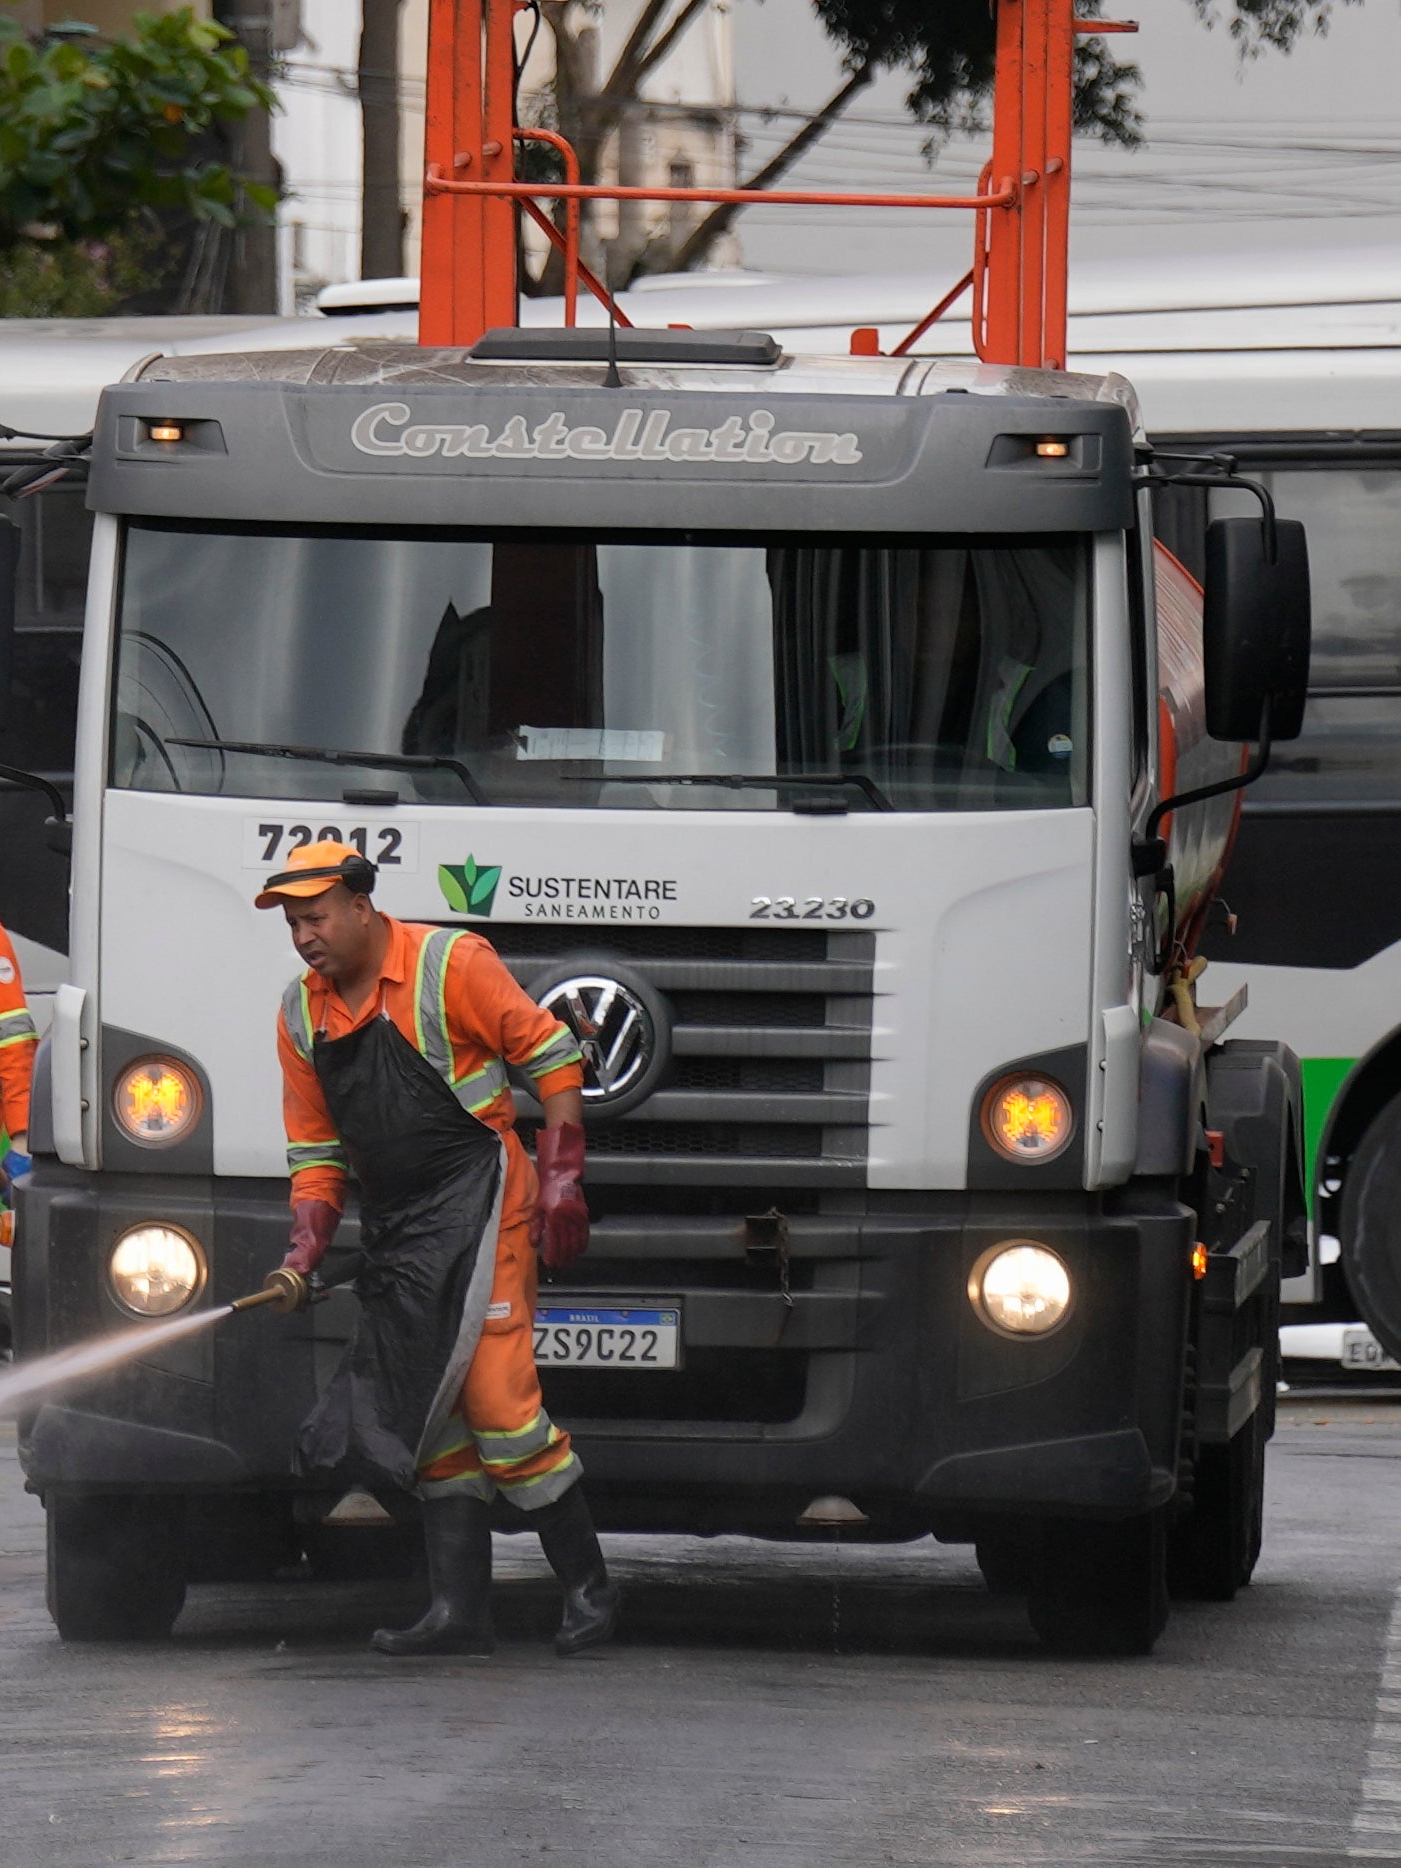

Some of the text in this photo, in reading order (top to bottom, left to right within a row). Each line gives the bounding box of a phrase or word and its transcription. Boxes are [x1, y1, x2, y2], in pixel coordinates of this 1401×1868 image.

[351, 402, 863, 464] Constellation
[508, 876, 678, 900] SUSTENTARE
[525, 903, 661, 919] SANEAMENTO
[569, 1314, 599, 1323] BRASIL
[533, 1328, 658, 1361] ZS9C22
